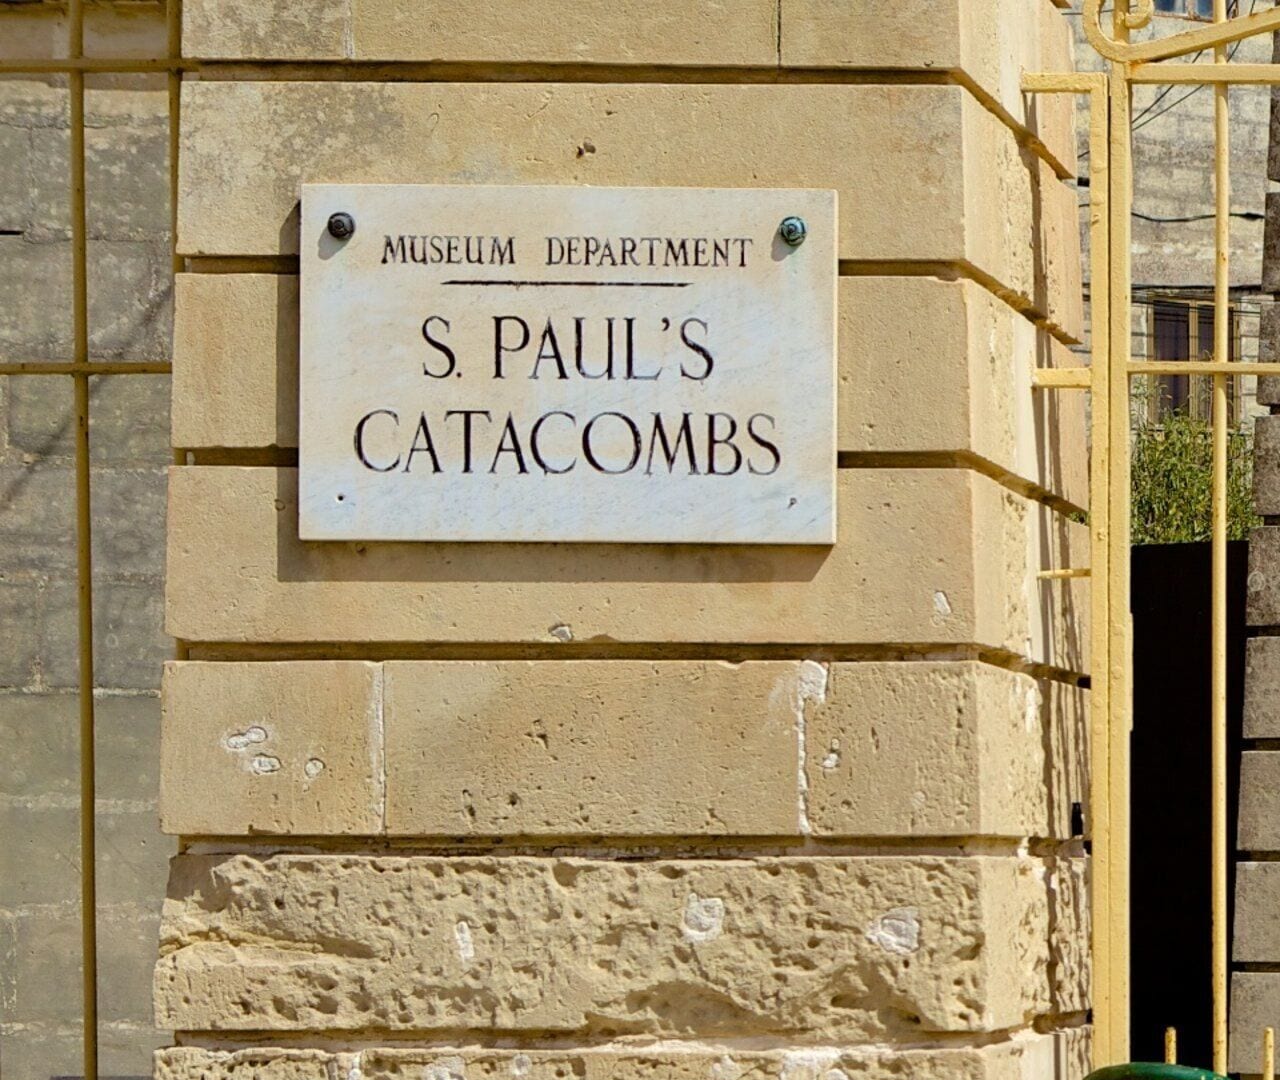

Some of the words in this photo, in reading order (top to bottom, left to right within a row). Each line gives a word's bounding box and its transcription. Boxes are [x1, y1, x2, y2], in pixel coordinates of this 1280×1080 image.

[381, 234, 517, 266] MUSEUM
[544, 236, 755, 268] DEPARTMENT
[422, 315, 463, 381] S.
[492, 315, 715, 381] PAUL'S
[353, 409, 782, 476] CATACOMBS
